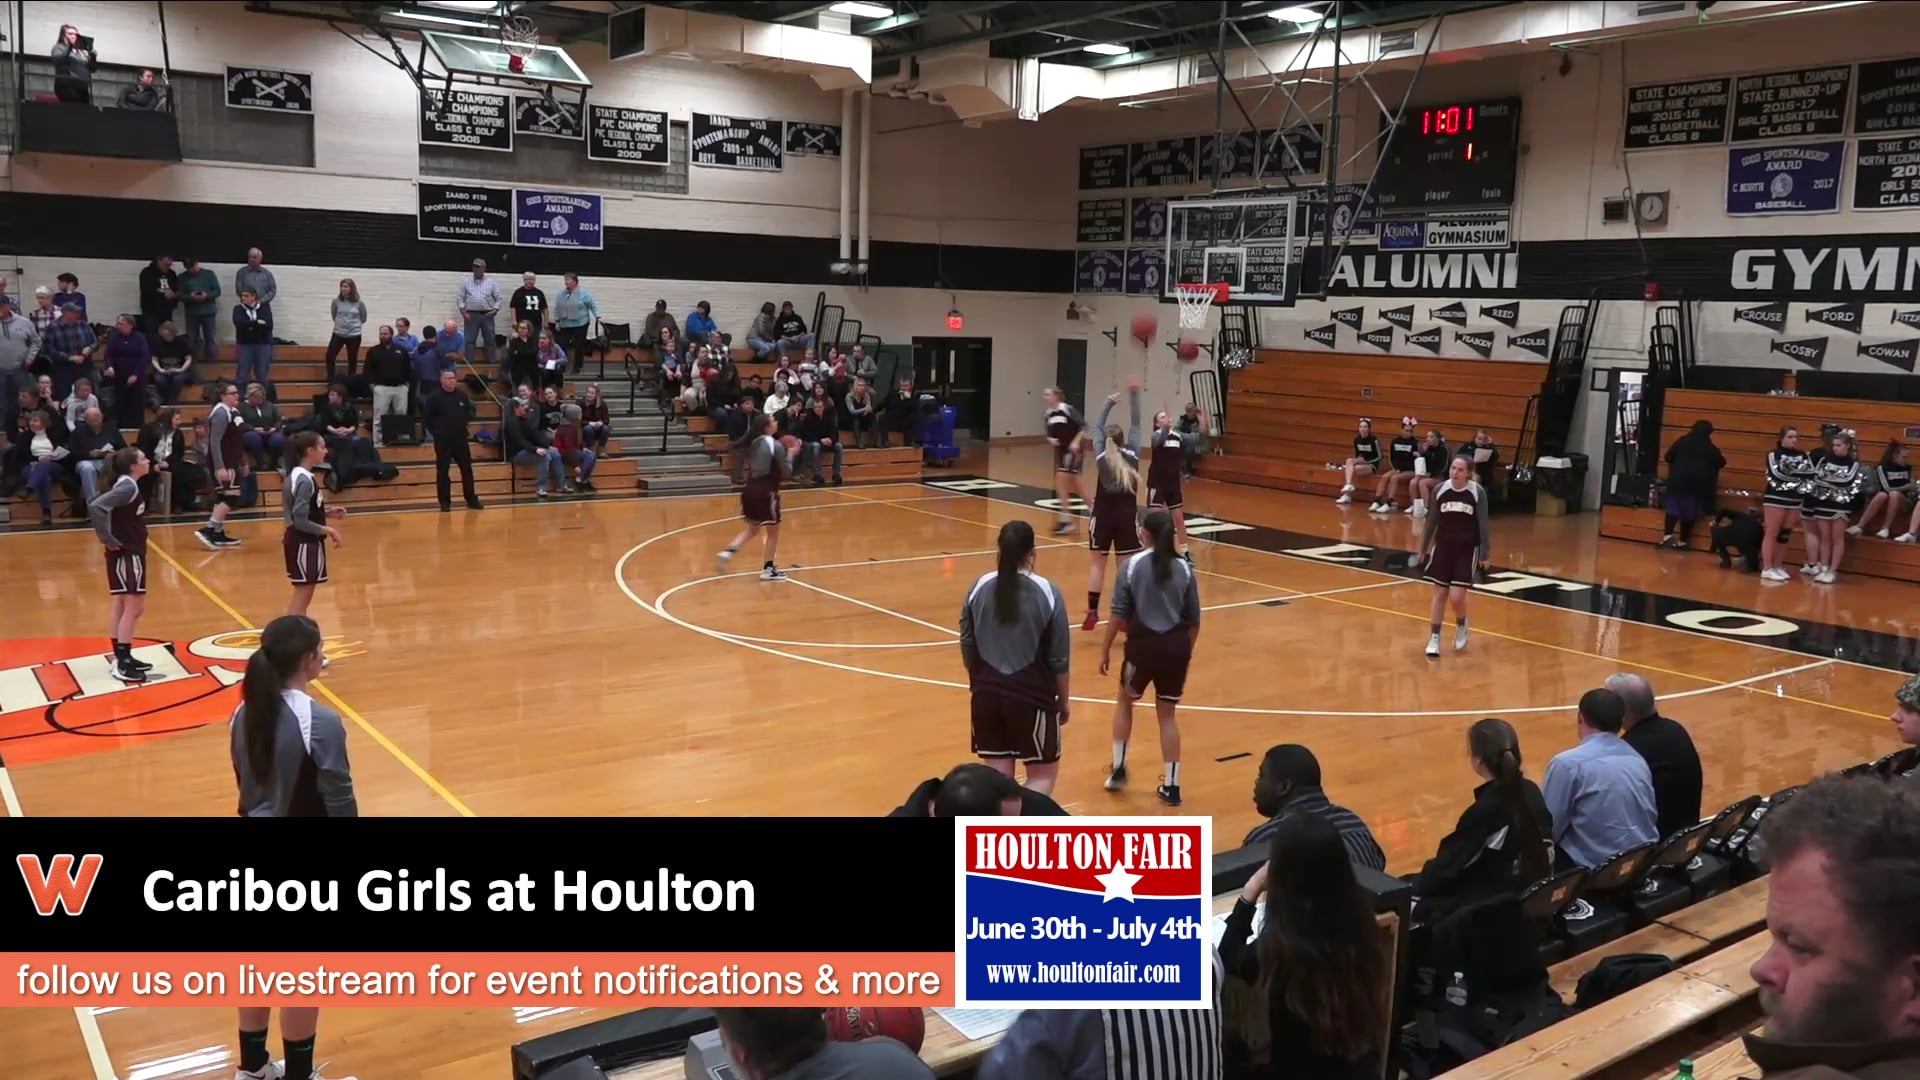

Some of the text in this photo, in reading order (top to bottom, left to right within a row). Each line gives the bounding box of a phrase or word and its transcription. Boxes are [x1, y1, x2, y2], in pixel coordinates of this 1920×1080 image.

[1804, 68, 1848, 84] CHAMPIONS
[1636, 81, 1723, 100] STATE CHAMPIONS
[1742, 82, 1841, 104] STATE RUNNER-UP
[457, 93, 504, 106] CHAMPIONS
[452, 103, 499, 116] CHAMPIONS
[595, 108, 662, 123] STATE CHAMPIONS
[1738, 108, 1839, 127] GIRLS BASKETBALL
[435, 123, 496, 136] CLASS C GOLF
[600, 119, 658, 132] PVC CHAMPIONS
[1659, 119, 1720, 132] BASKETBALL
[1759, 122, 1802, 137] CLASS
[603, 139, 627, 149] CLASS
[694, 128, 750, 150] SPORTSMANSHIP
[1648, 132, 1687, 144] CLASS
[1877, 141, 1902, 152] STATE
[1763, 148, 1830, 162] SPORTSMANSHIP
[736, 156, 776, 168] BASKETBALL
[1765, 160, 1802, 171] AWARD
[1812, 178, 1834, 189] 2017
[543, 195, 592, 209] SPORTSMANSHIP
[545, 204, 573, 213] AWARD
[1754, 200, 1806, 209] BASEBALL
[424, 203, 508, 217] SPORTSMANSHIP AWARD
[519, 219, 541, 228] EAST
[579, 223, 599, 231] 2014
[455, 227, 499, 236] BASKETBALL
[1383, 222, 1420, 240] AQUAFINA
[1429, 230, 1505, 244] GYMNASIUM
[1328, 254, 1518, 288] ALUMNI
[525, 296, 539, 310] H
[1492, 309, 1514, 318] REED
[1741, 310, 1782, 322] CROUSE
[1822, 312, 1854, 322] FORD
[1311, 332, 1333, 340] DRAKE
[1462, 335, 1492, 348] PEABODY
[1516, 338, 1546, 346] SADLER
[1783, 344, 1819, 358] COSBY
[1869, 347, 1910, 358] COWAN
